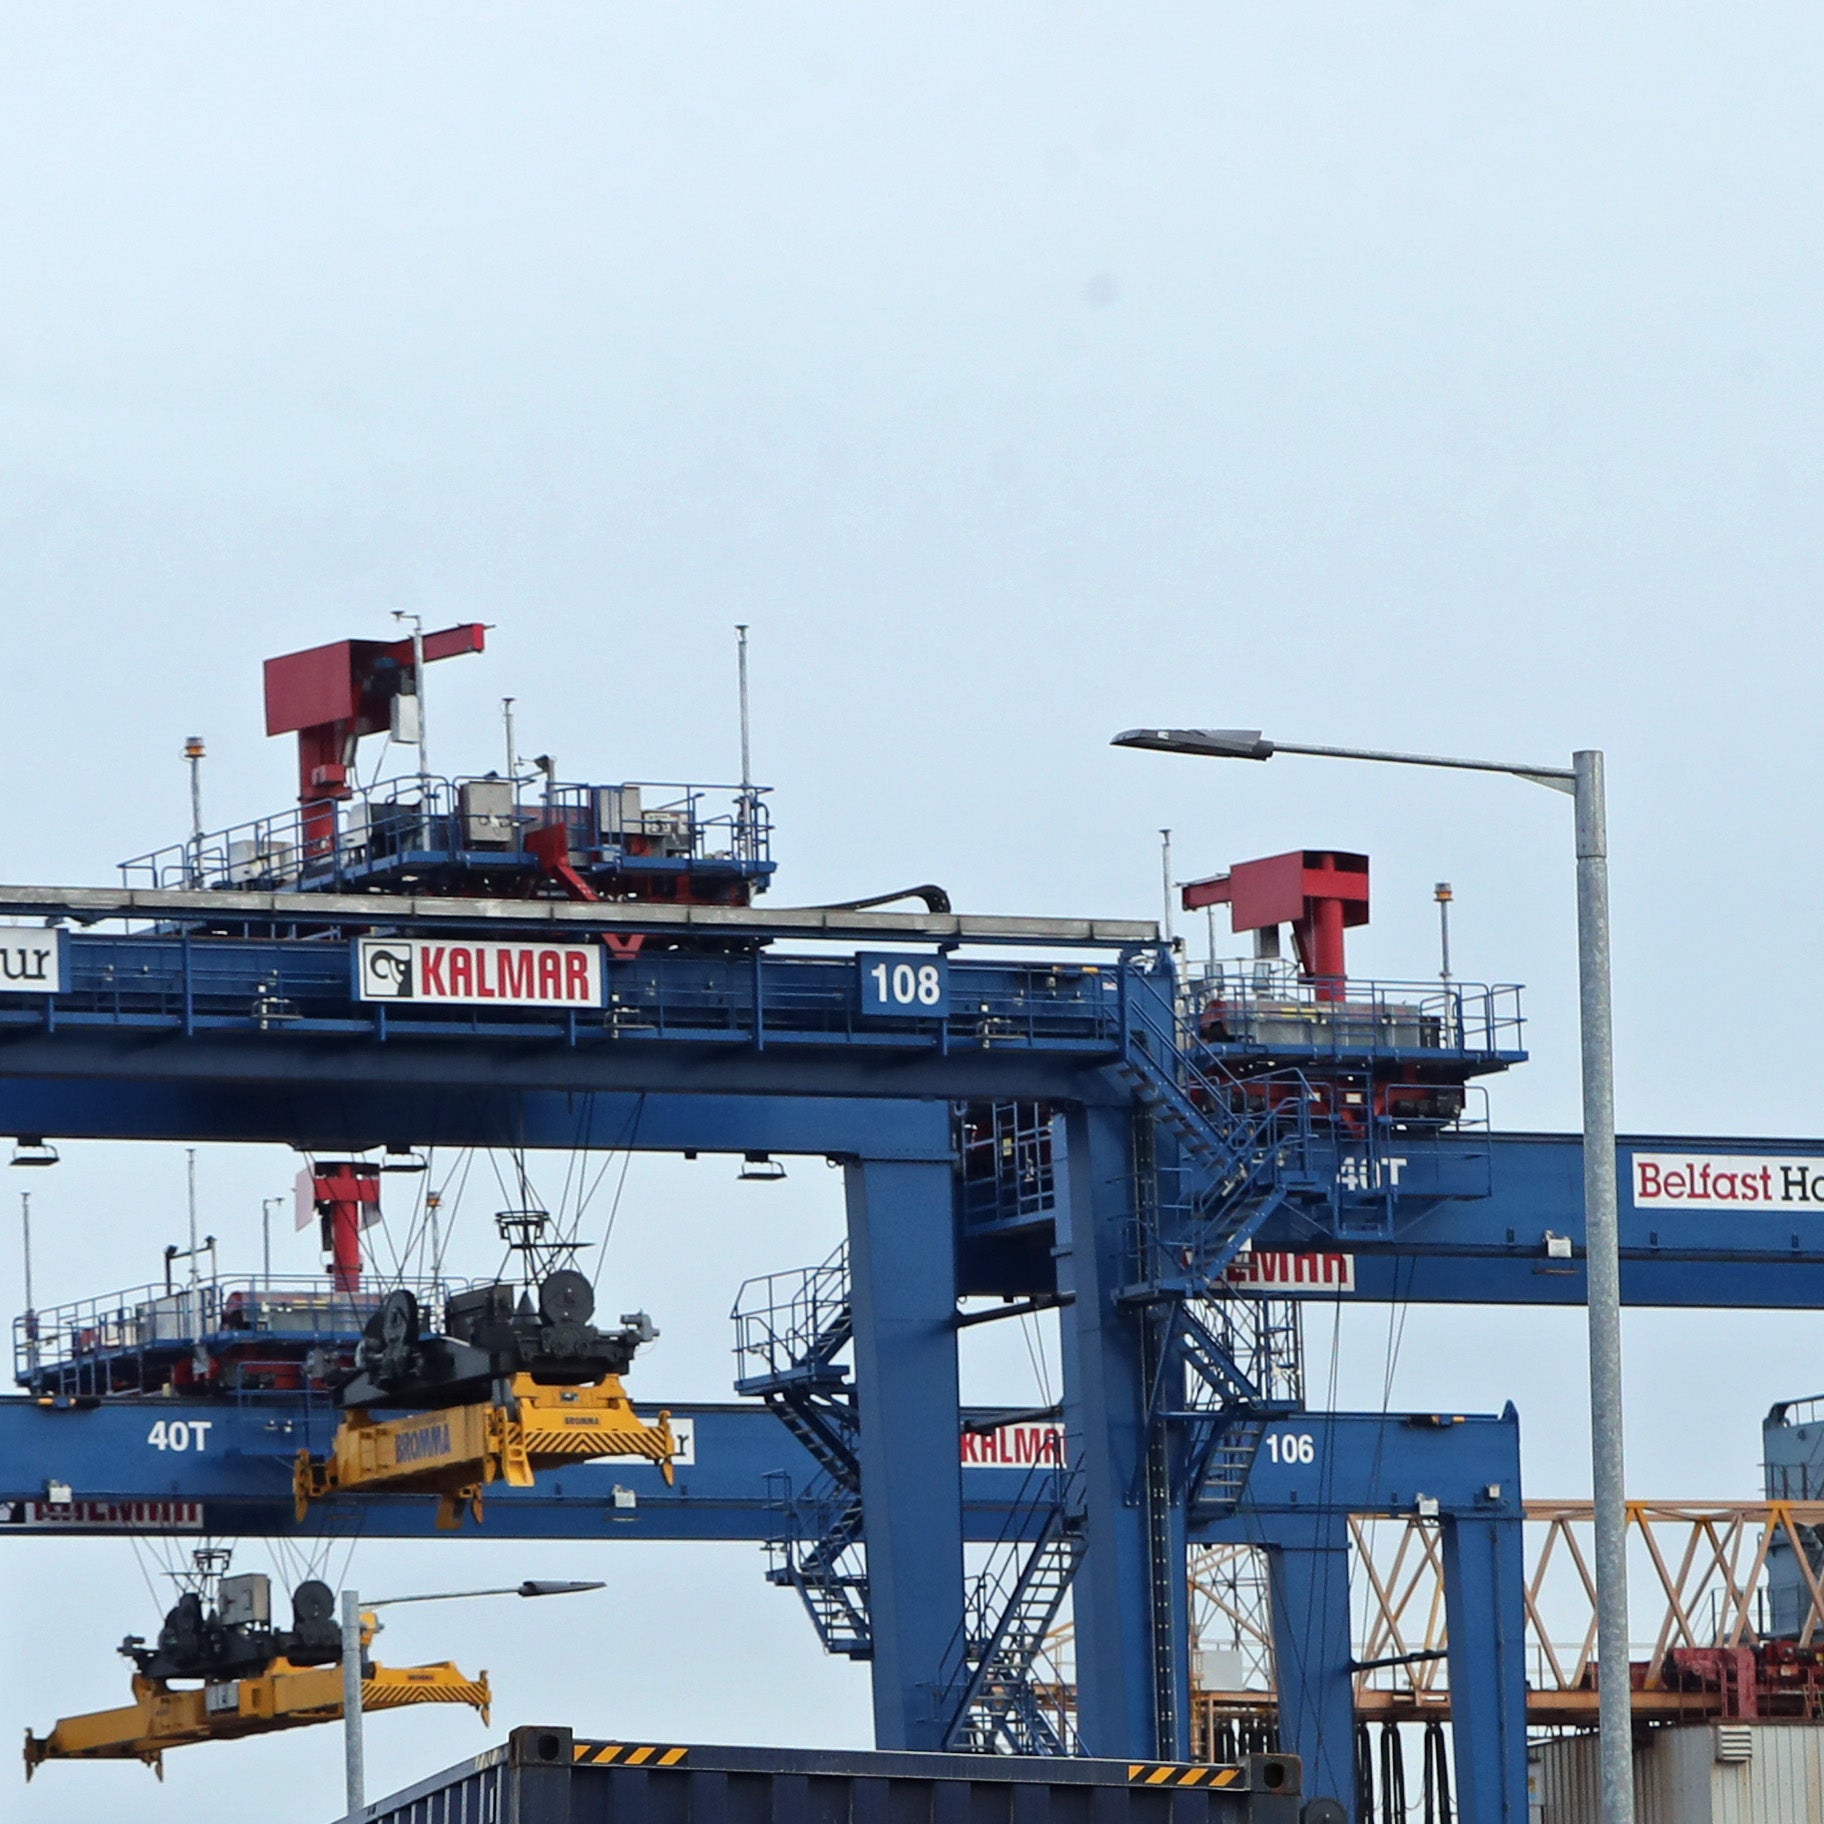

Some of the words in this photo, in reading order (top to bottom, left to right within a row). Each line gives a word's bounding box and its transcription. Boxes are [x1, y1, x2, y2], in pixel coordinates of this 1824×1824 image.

[421, 946, 589, 1001] KALMAR
[871, 963, 940, 1005] 108
[1638, 1161, 1773, 1201] Belfast
[147, 1421, 212, 1451] 40T
[961, 1424, 1066, 1465] KALMA
[1265, 1434, 1314, 1464] 106
